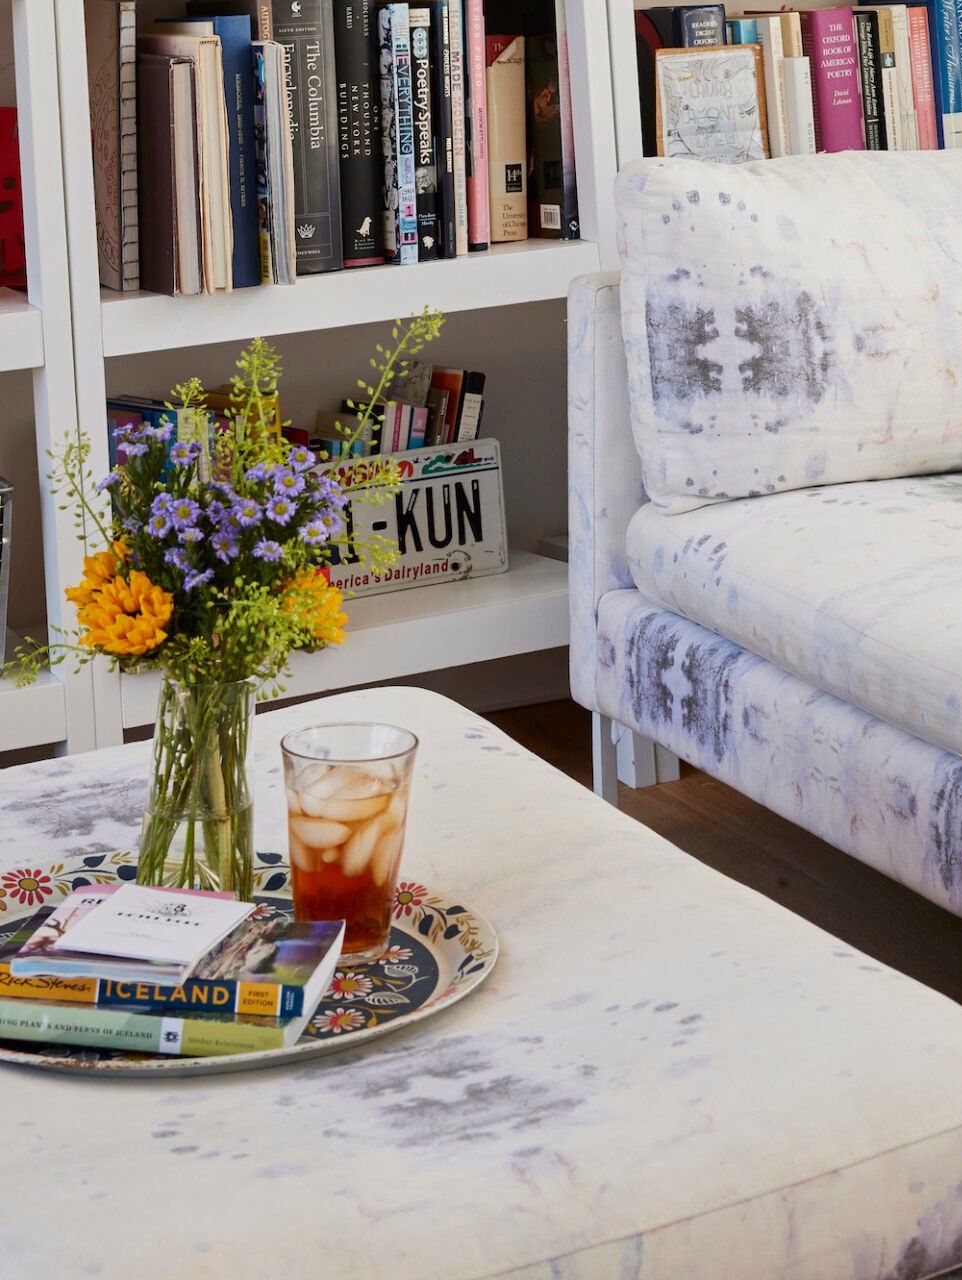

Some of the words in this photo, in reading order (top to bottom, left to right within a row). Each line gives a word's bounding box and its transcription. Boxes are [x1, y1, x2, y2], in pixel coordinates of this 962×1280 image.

[345, 6, 353, 29] HARRIS
[449, 9, 462, 91] HANDMADE
[822, 35, 850, 44] OXFORD
[823, 47, 841, 55] BOOK
[842, 46, 852, 54] OF
[305, 41, 321, 70] The
[474, 46, 483, 87] PHOTO
[820, 57, 855, 68] AMERICAN
[413, 59, 430, 110] Poetry
[827, 69, 853, 78] POETRY
[946, 46, 959, 105] Thesaurus
[307, 75, 324, 150] Columbia
[350, 85, 359, 112] NEW
[396, 55, 413, 154] EVERYTHING
[339, 82, 349, 159] BUILDINGS
[362, 83, 371, 157] THOUSAND
[452, 96, 464, 157] MODERN
[352, 120, 361, 155] YORK
[415, 112, 433, 164] Speaks
[328, 572, 381, 590] erica's
[384, 558, 449, 582] Dairyland
[0, 973, 28, 989] Rick
[106, 981, 230, 1005] ICELAND
[249, 991, 269, 999] FIRST
[243, 998, 274, 1007] EDITION
[53, 1022, 73, 1032] AND
[74, 1024, 100, 1034] FERNS
[103, 1027, 113, 1036] OF
[115, 1028, 152, 1040] ICELAND
